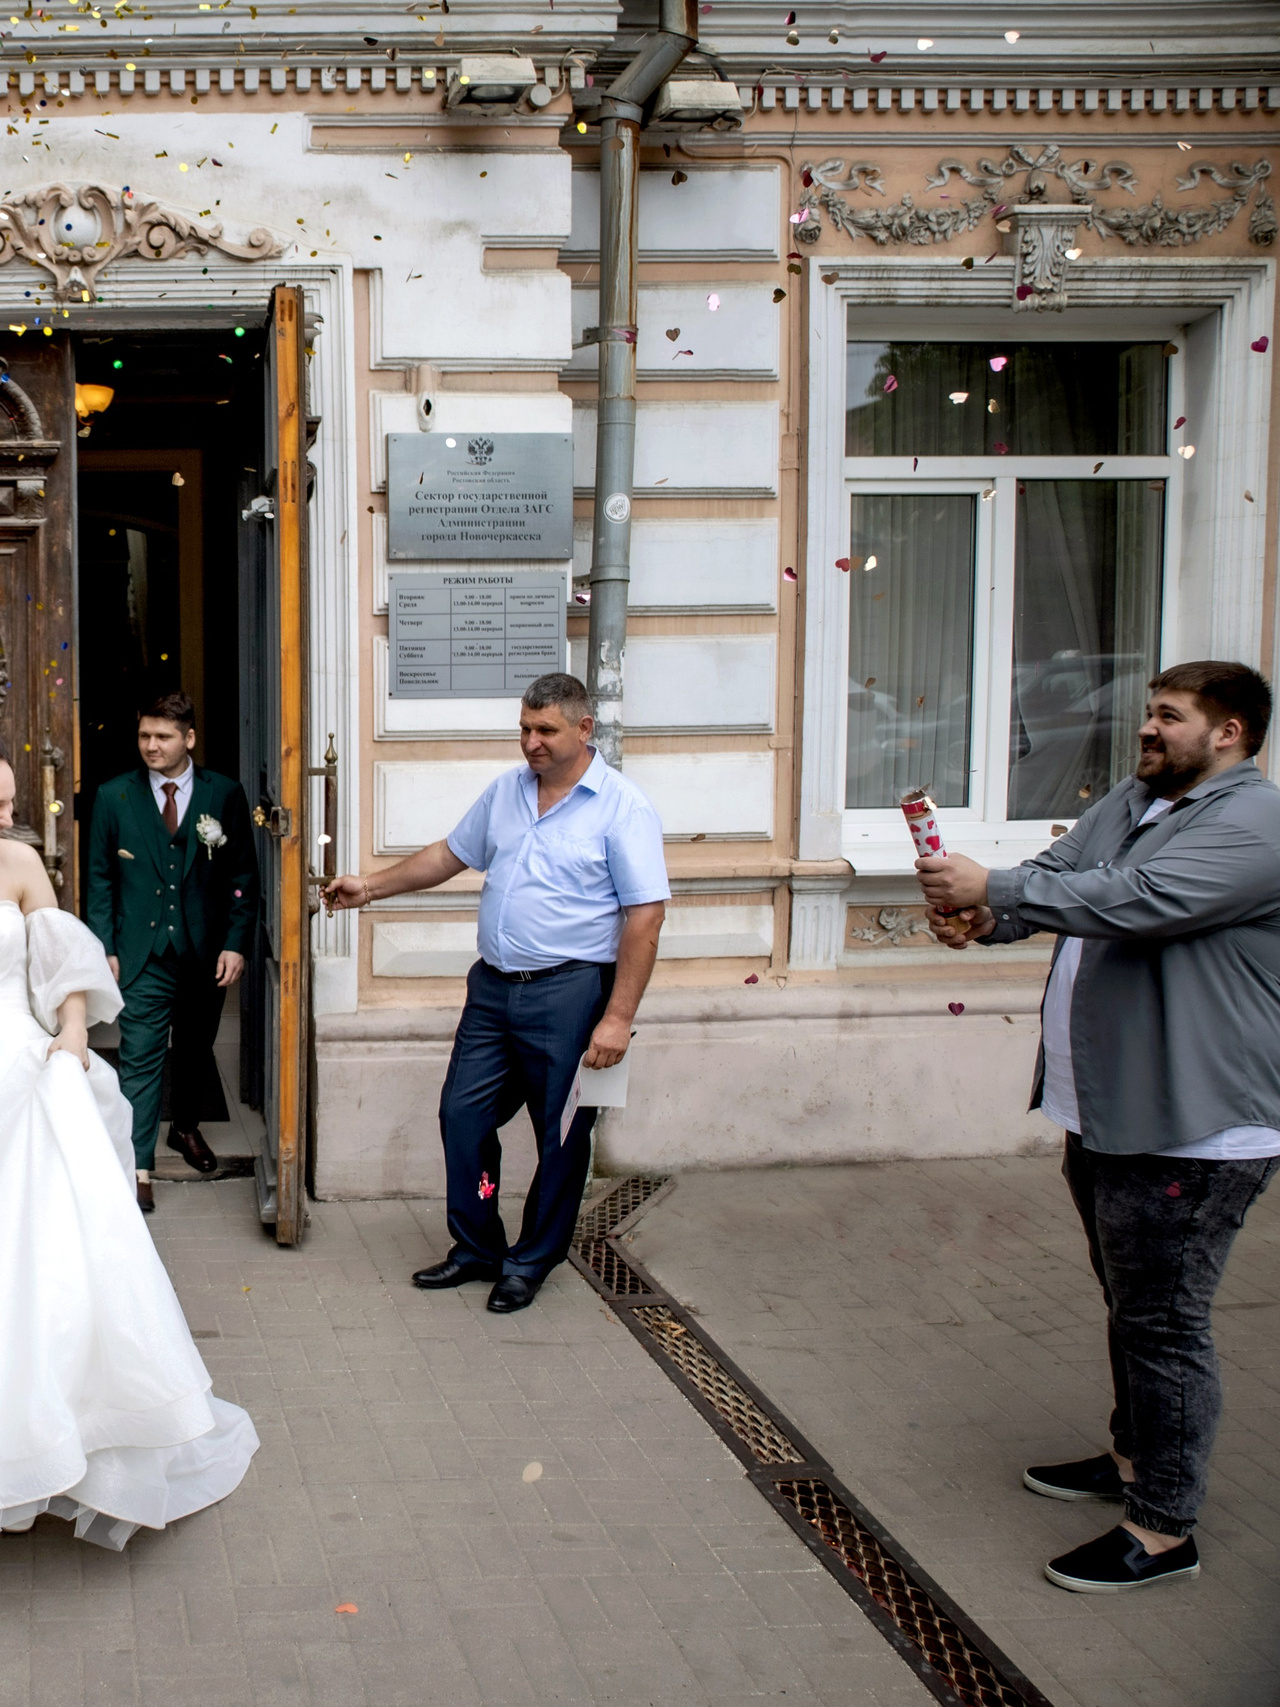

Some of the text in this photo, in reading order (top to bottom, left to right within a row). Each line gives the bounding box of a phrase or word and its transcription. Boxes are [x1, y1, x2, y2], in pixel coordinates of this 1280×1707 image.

[415, 491, 547, 502] Сектор государственной
[408, 504, 554, 516] регистрации Отдела ЗАГС
[438, 519, 525, 529] Администрации
[421, 532, 541, 543] города Новочеркасска
